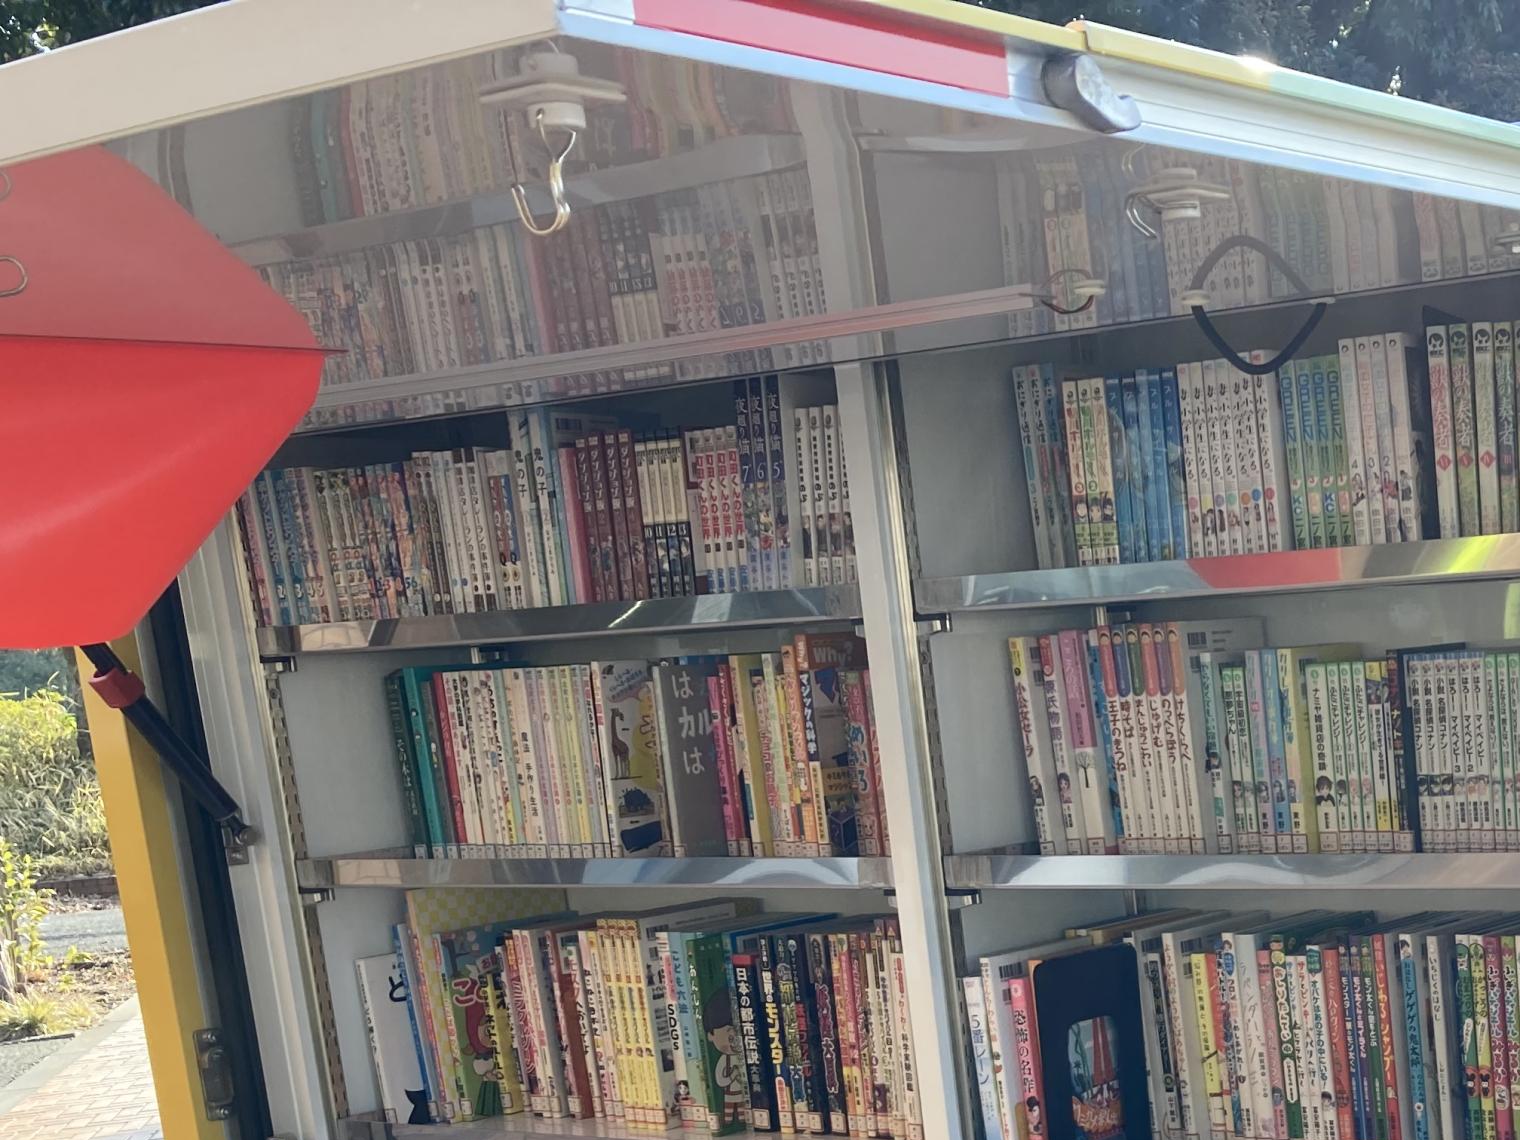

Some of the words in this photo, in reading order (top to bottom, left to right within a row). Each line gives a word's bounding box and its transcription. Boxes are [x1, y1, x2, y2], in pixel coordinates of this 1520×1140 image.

[1281, 376, 1297, 443] GREEN
[1297, 370, 1314, 441] GREEN
[1312, 368, 1328, 440] GREEN
[1327, 370, 1343, 440] GREEN
[1430, 364, 1450, 450] 獣の奏者
[1452, 364, 1472, 450] 獣の奏者
[1499, 361, 1517, 446] 獣の奏者
[535, 447, 547, 495] 鬼の子
[742, 465, 750, 483] 7
[757, 463, 765, 479] 6
[773, 462, 781, 478] 5
[1351, 459, 1359, 470] 4
[1367, 458, 1376, 468] 3
[1383, 455, 1391, 466] 2
[706, 452, 720, 540] 町田くんの世界
[717, 451, 732, 539] 町田くんの世界
[728, 448, 744, 537] 町田くんの世界
[1325, 493, 1335, 513] KC
[667, 525, 676, 536] 12
[813, 642, 853, 667] Why?
[672, 671, 694, 699] は
[1044, 679, 1063, 741] 源氏物語
[1411, 678, 1419, 696] 小説
[1424, 678, 1432, 696] 小説
[1436, 677, 1445, 695] 小説
[802, 673, 819, 755] マジックの科学
[1016, 681, 1034, 758] 小公女セーラ
[1108, 699, 1127, 772] 王子のきつね
[1120, 700, 1135, 738] 時そば
[1135, 699, 1152, 768] まんじゅうこわい
[1150, 699, 1164, 748] じゅげむ
[1163, 698, 1177, 764] のっぺらぼう
[1176, 697, 1192, 761] けちくらべ
[1413, 698, 1423, 751] 名探偵コナン
[1425, 698, 1435, 751] 名探偵コナン
[1438, 697, 1448, 750] 名探偵コナン
[1451, 716, 1461, 763] マイベイビー
[1464, 715, 1474, 763] マイベイビー
[1474, 714, 1485, 766] マイベイビー
[683, 746, 705, 775] は
[1454, 765, 1461, 773] 3
[1467, 765, 1474, 773] 2
[672, 950, 689, 1015] こども六法
[1272, 965, 1294, 1043] おしりたんてい
[1427, 955, 1442, 1022] いちじくのはなし
[667, 1004, 680, 1051] SDGs
[736, 967, 761, 1066] 日本の都市伝説
[761, 969, 786, 1076] 世界のモンスター
[970, 1014, 990, 1086] 5番レーン
[1013, 1009, 1035, 1093] 恐怖の名作
